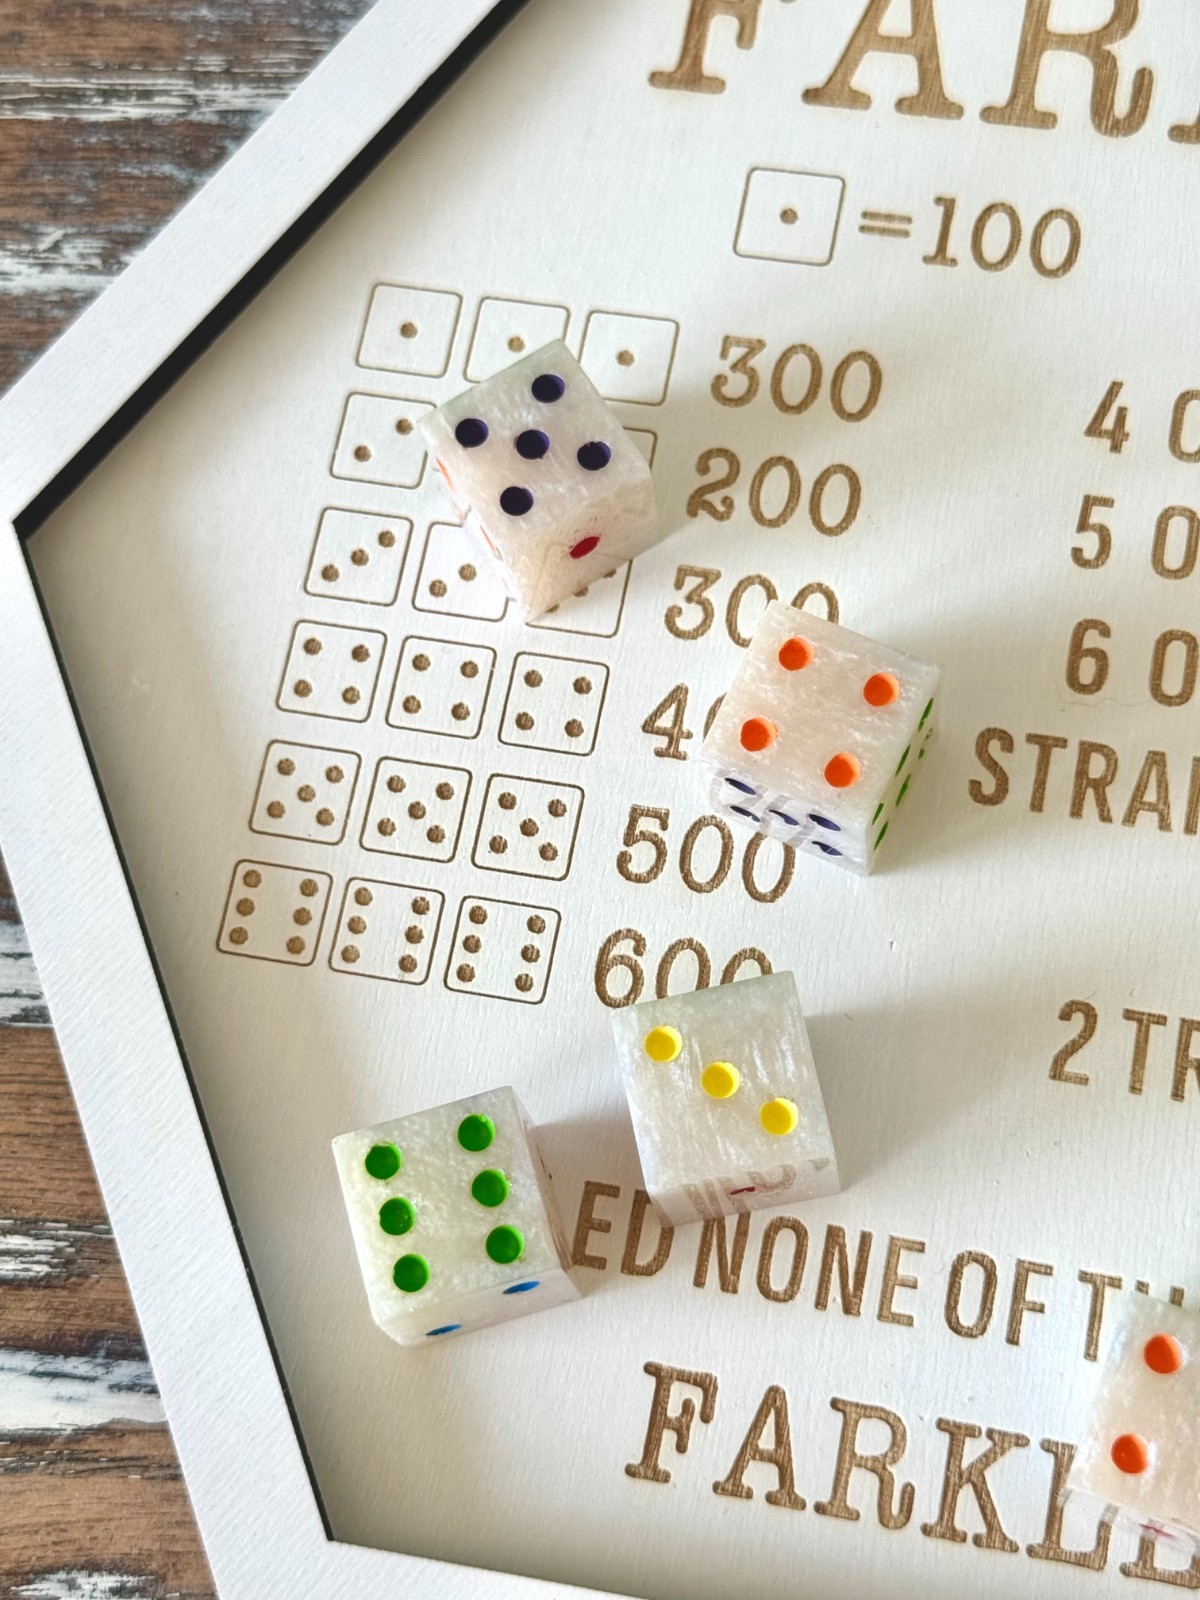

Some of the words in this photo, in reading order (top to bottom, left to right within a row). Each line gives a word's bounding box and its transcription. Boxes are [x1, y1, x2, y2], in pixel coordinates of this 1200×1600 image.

[649, 0, 1200, 144] FAR
[710, 335, 882, 423] 300
[1083, 380, 1130, 454] 4
[686, 447, 861, 537] 200
[1071, 494, 1115, 570] 5
[1065, 618, 1111, 695] 6
[616, 804, 795, 903] 500
[1048, 999, 1098, 1086] 2
[692, 1209, 926, 1327] NONE
[944, 1250, 1053, 1346] OF
